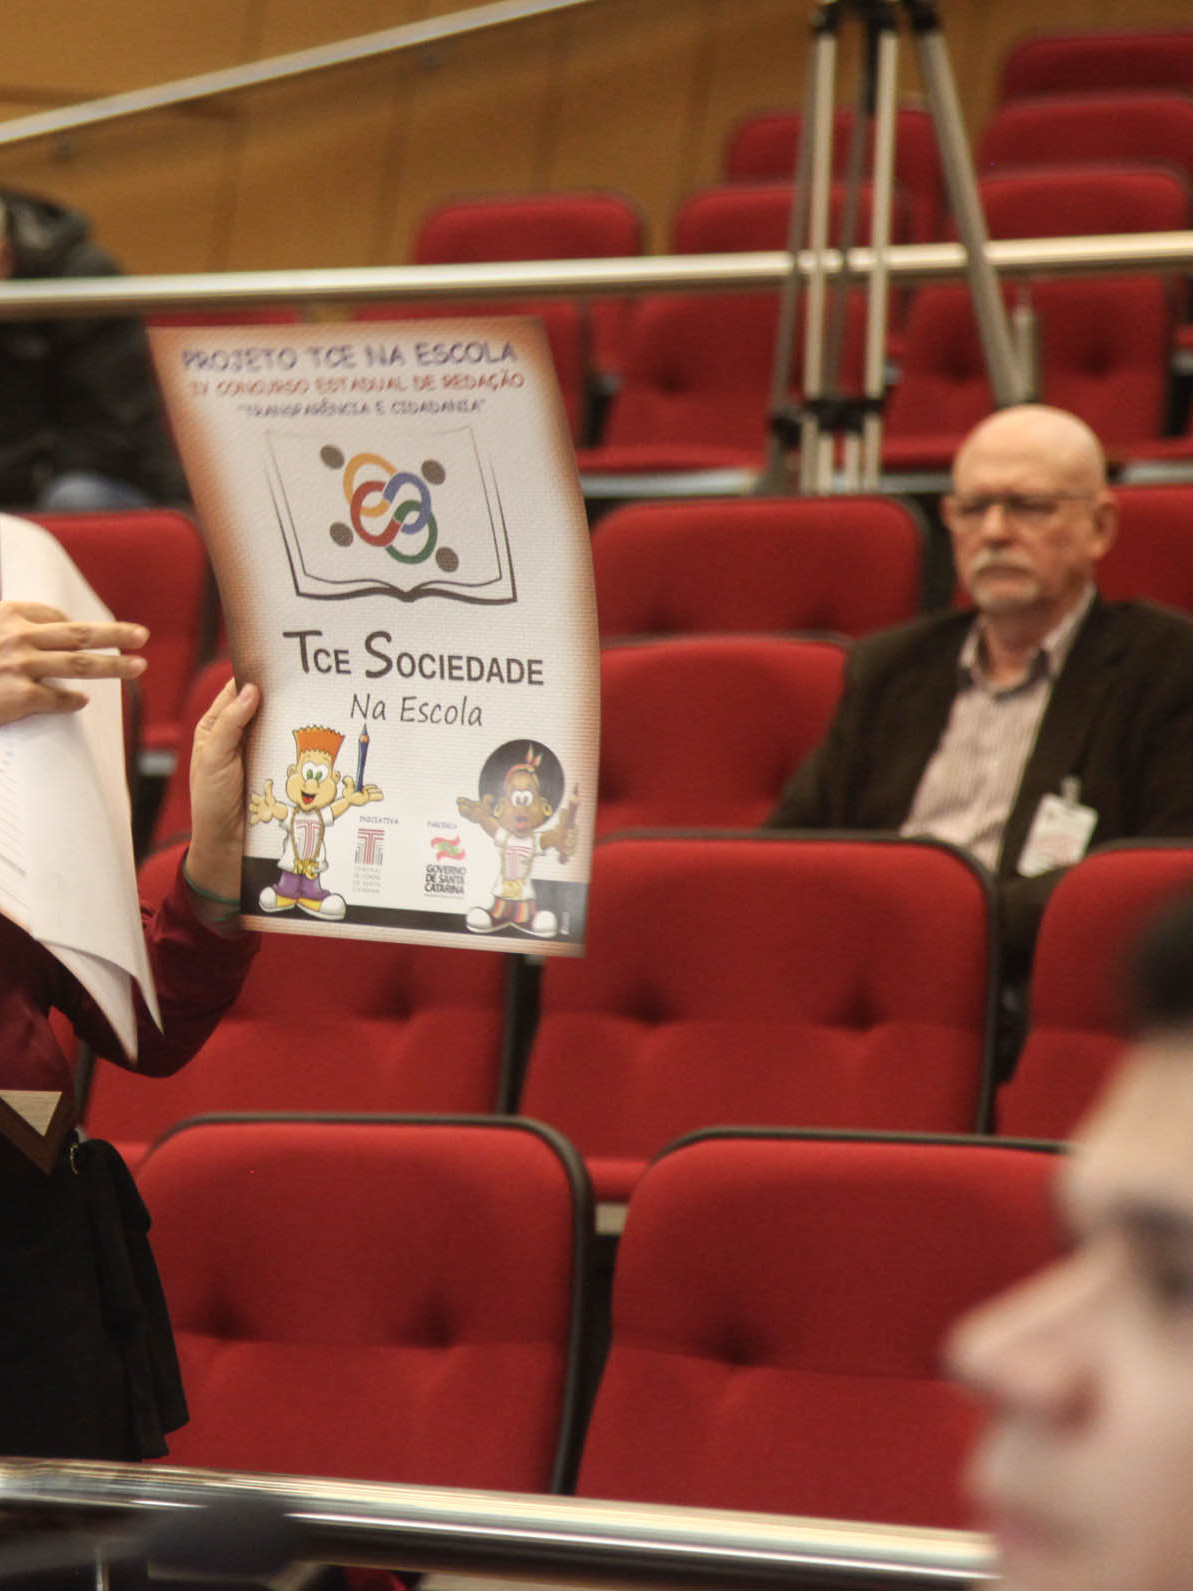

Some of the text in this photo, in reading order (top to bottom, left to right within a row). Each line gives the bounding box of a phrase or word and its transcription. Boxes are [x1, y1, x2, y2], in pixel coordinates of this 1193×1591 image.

[183, 339, 518, 372] PROJETO TCE NA ESCOLA
[216, 377, 309, 397] CONCURSO
[315, 374, 408, 394] ESTADUAL
[412, 373, 436, 391] DE
[441, 367, 526, 391] REDAÇÃO
[376, 400, 386, 415] E
[350, 693, 483, 727] Na Escola
[426, 864, 467, 876] GOVERNO
[425, 873, 465, 886] DE SANTA
[424, 883, 465, 895] CATARINA
